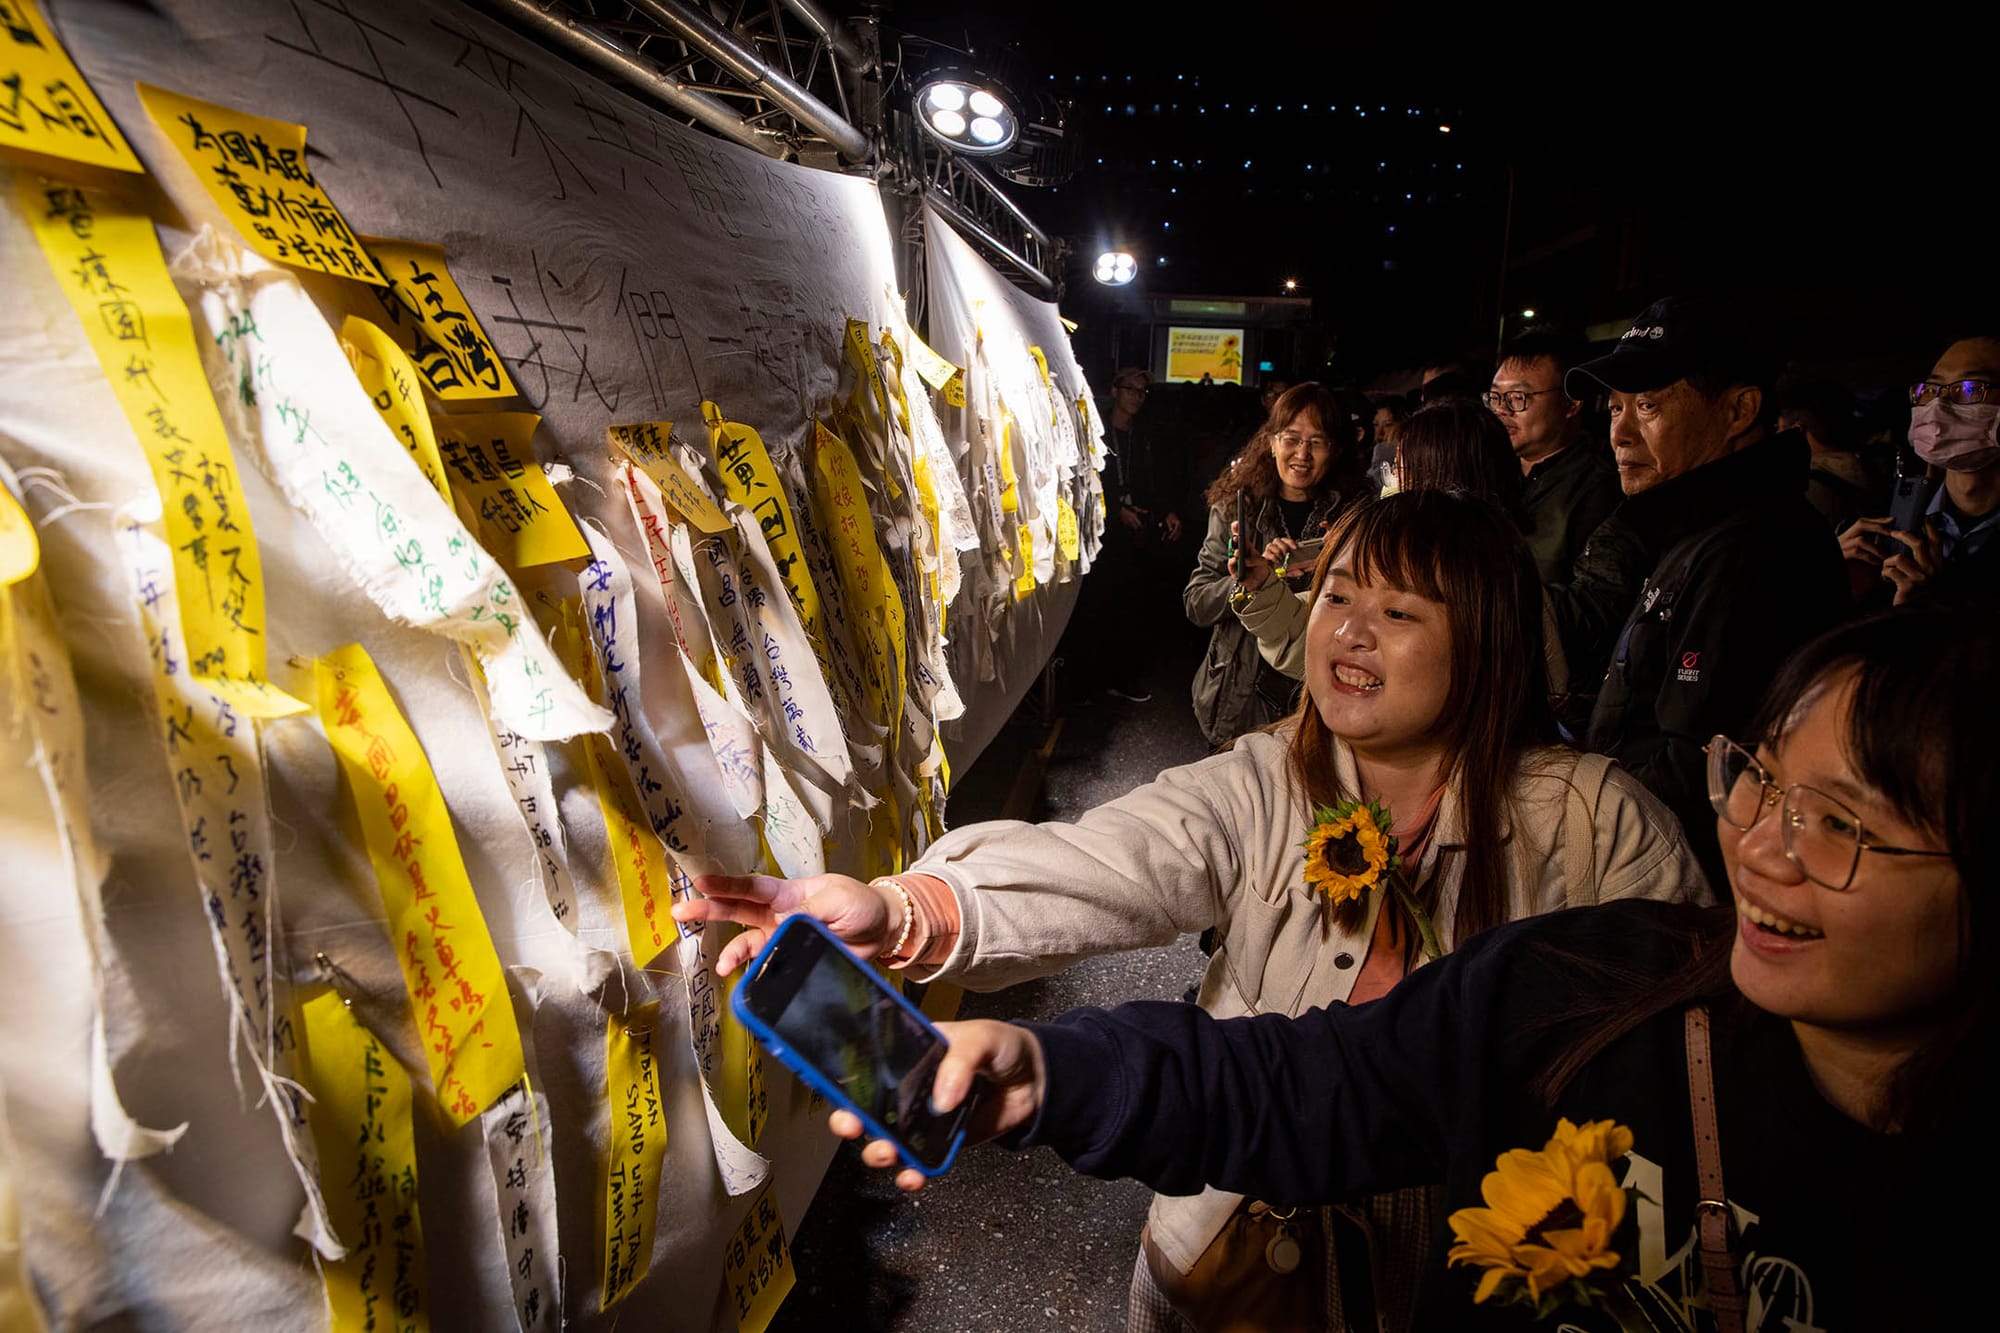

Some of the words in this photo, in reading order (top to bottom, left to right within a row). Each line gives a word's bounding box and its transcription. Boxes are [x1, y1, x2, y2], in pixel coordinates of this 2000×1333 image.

[178, 112, 315, 188] 為國為民
[253, 221, 377, 278] 堅持到底
[409, 322, 501, 393] 台灣
[441, 438, 525, 484] 黃國昌
[640, 1031, 658, 1127] TIBETAN
[626, 1083, 645, 1155] STAND
[631, 1166, 645, 1217] with
